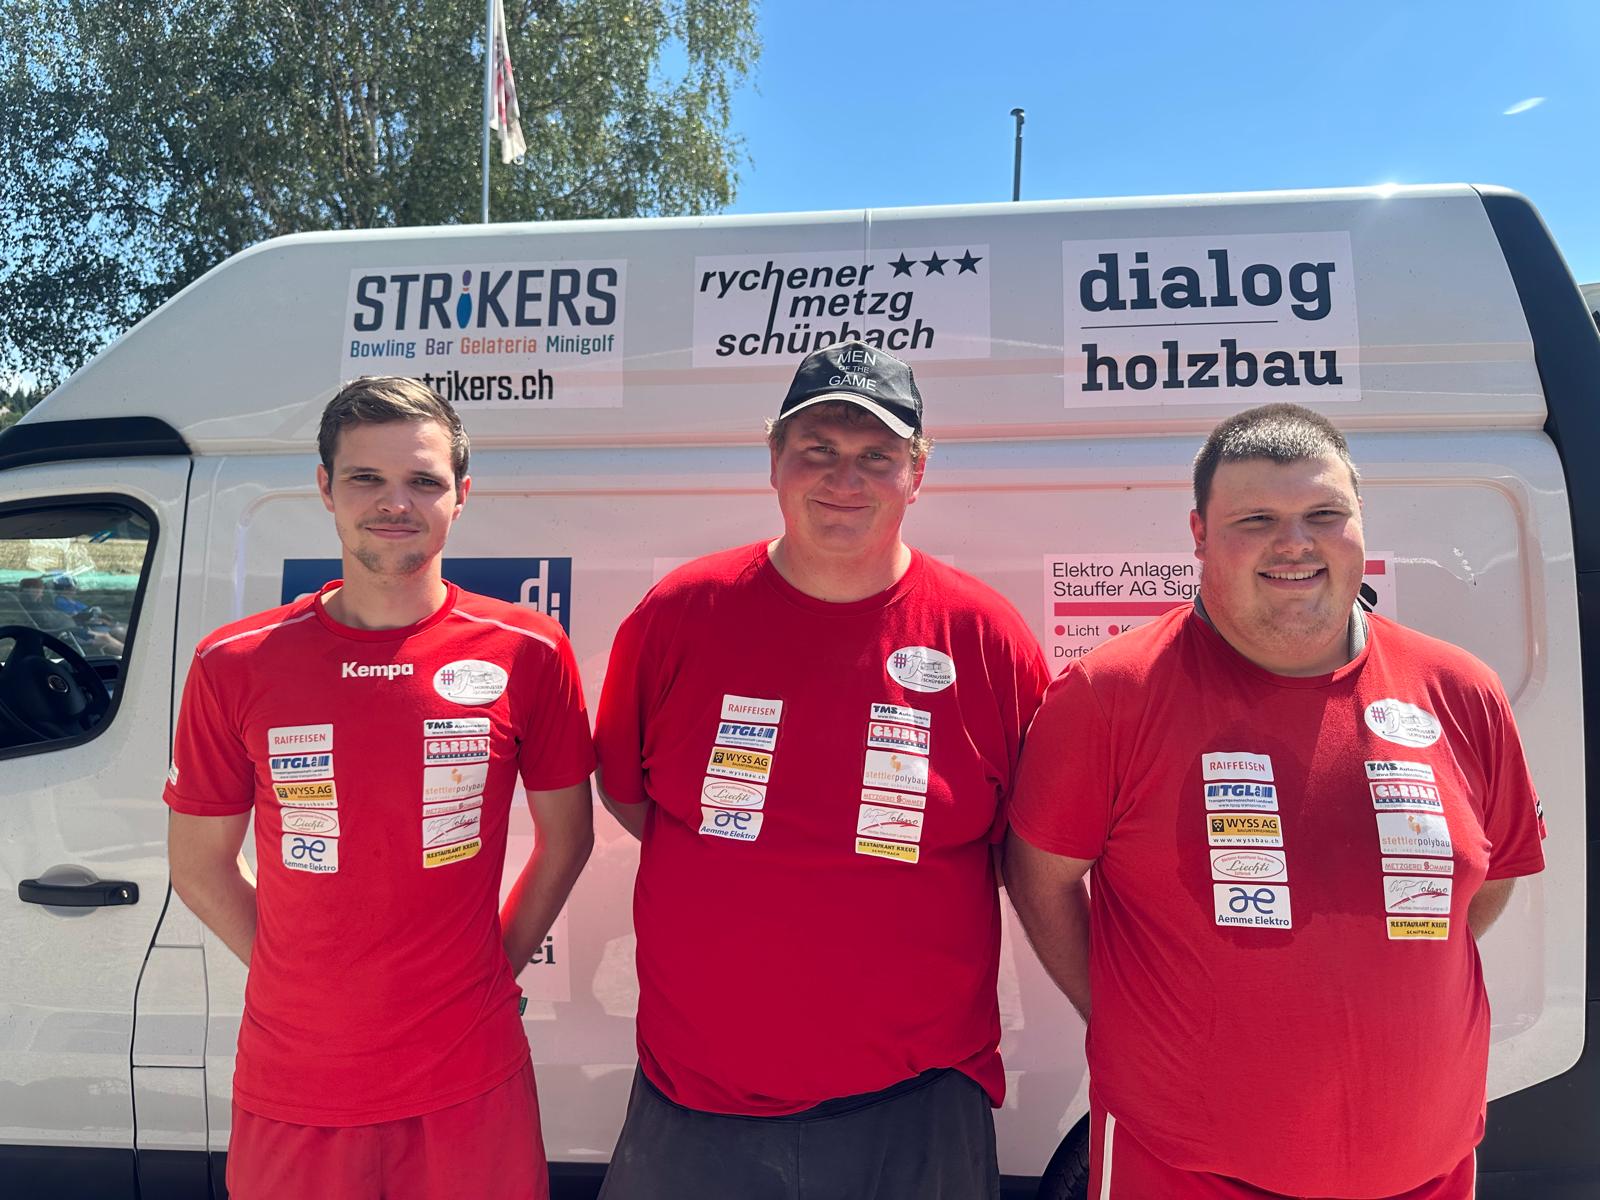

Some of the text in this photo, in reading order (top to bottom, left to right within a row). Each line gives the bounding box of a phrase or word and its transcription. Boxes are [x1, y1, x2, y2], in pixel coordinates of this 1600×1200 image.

[700, 260, 875, 299] rychener
[1079, 249, 1336, 321] dialog
[789, 289, 914, 322] metzg
[350, 334, 615, 358] Bowling Bar Gelateria Minigolf
[837, 350, 876, 366] MEN
[853, 366, 870, 374] THE
[1081, 338, 1343, 392] holzbau
[828, 374, 877, 391] GAME
[1053, 561, 1194, 580] Elektro Anlagen
[1053, 581, 1124, 597] Stauffer
[1129, 580, 1157, 596] AG
[1067, 624, 1100, 637] Licht
[341, 661, 414, 680] Kempa
[728, 703, 776, 716] RAIFFEISEN
[873, 705, 898, 715] TMS
[426, 721, 453, 730] TMS
[730, 725, 757, 737] TGL
[274, 733, 326, 745] RAIFFEISEN
[872, 725, 927, 744] GERBER
[429, 740, 487, 754] GERBER
[281, 757, 311, 769] TGL
[726, 752, 753, 764] WYSS
[754, 757, 769, 767] AG
[1209, 761, 1266, 772] RAIFFEISEN
[1367, 763, 1398, 772] TMS
[287, 785, 332, 795] WYSS AG
[1220, 784, 1254, 797] TGL
[1225, 818, 1277, 829] WYSS AG
[700, 826, 756, 840] Aemme Elektro
[309, 862, 337, 872] Elektro
[1226, 860, 1270, 875] Liechti
[1217, 914, 1290, 927] Aemme Elektro
